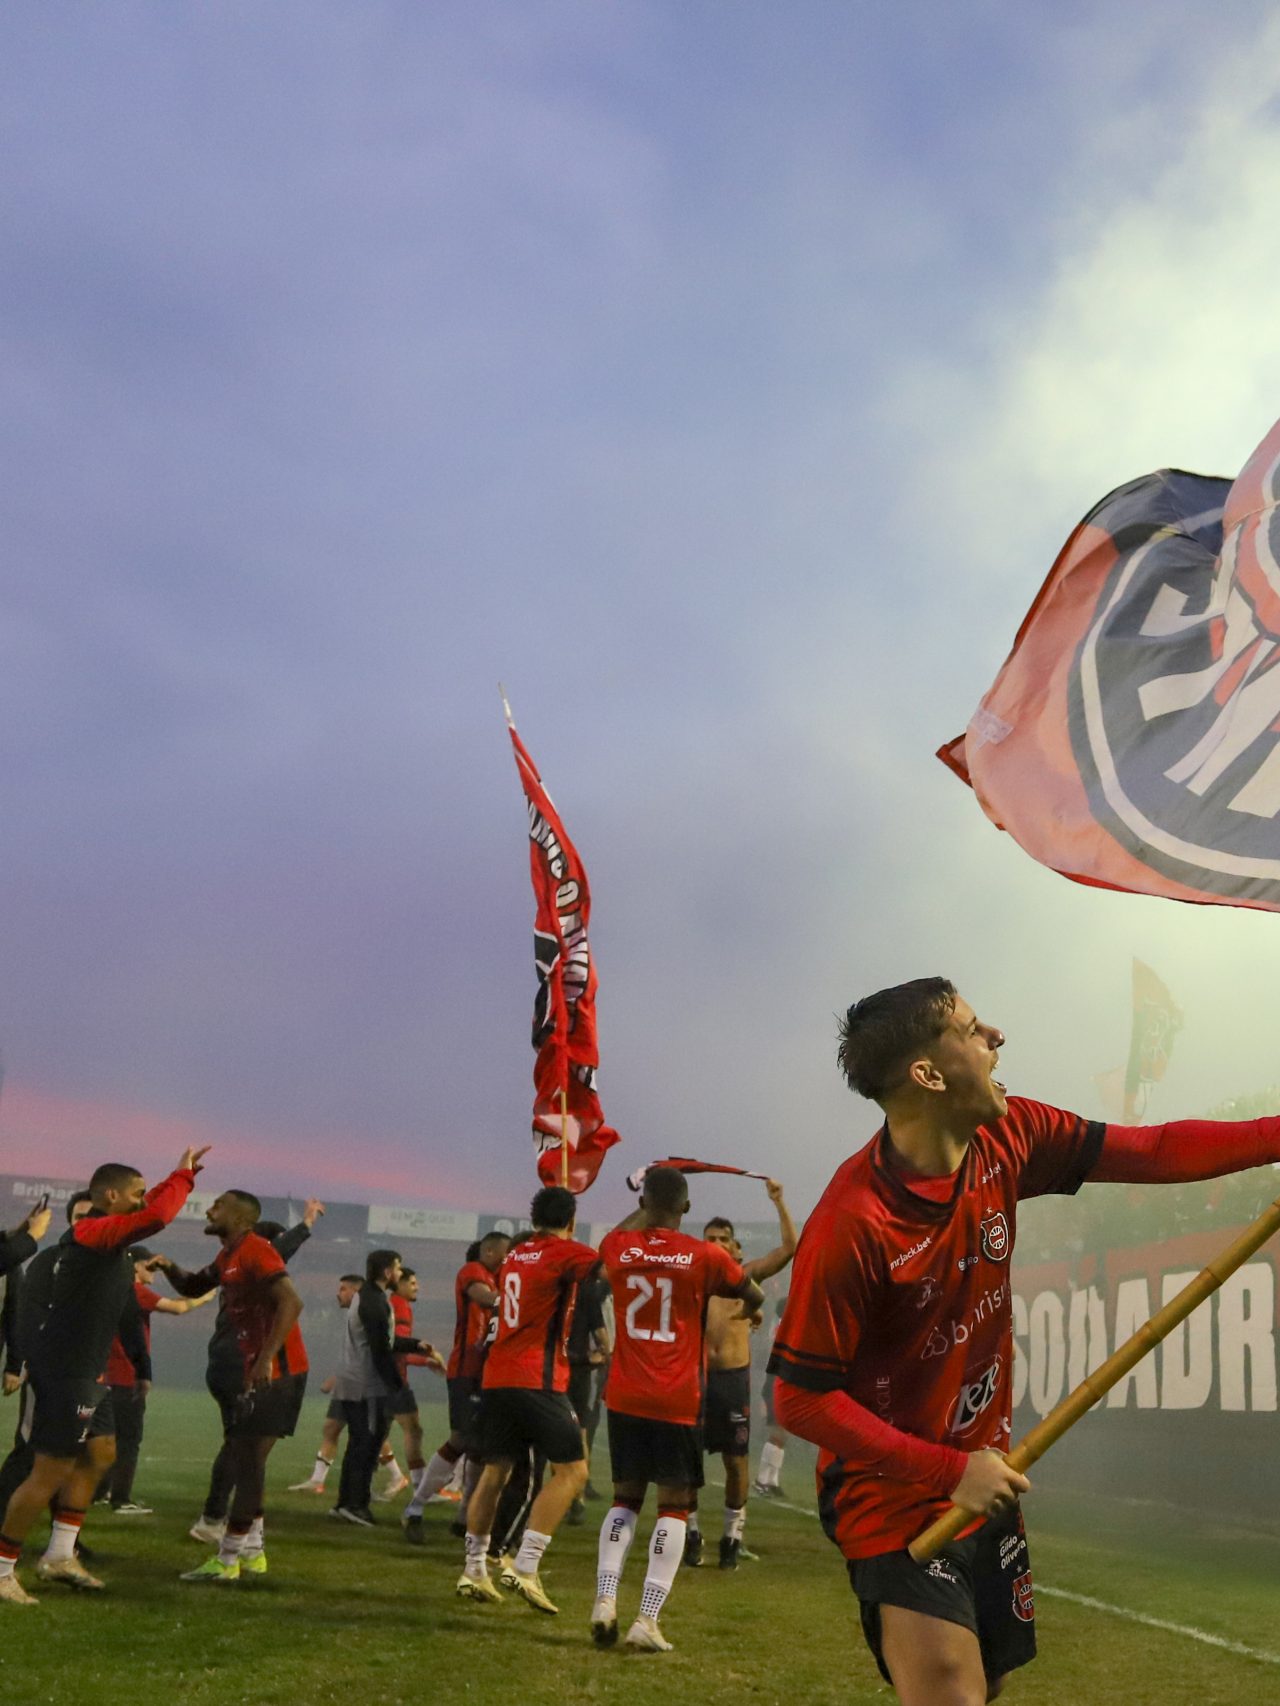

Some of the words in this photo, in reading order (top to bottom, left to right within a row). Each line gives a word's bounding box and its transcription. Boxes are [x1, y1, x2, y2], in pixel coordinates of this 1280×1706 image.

[643, 1251, 694, 1265] vetorial
[890, 1237, 932, 1271] mrjack.bet
[504, 1272, 521, 1328] 8
[626, 1274, 676, 1343] 21
[610, 1518, 625, 1542] GEB
[654, 1529, 668, 1555] GEB
[1000, 1535, 1018, 1557] Gildo
